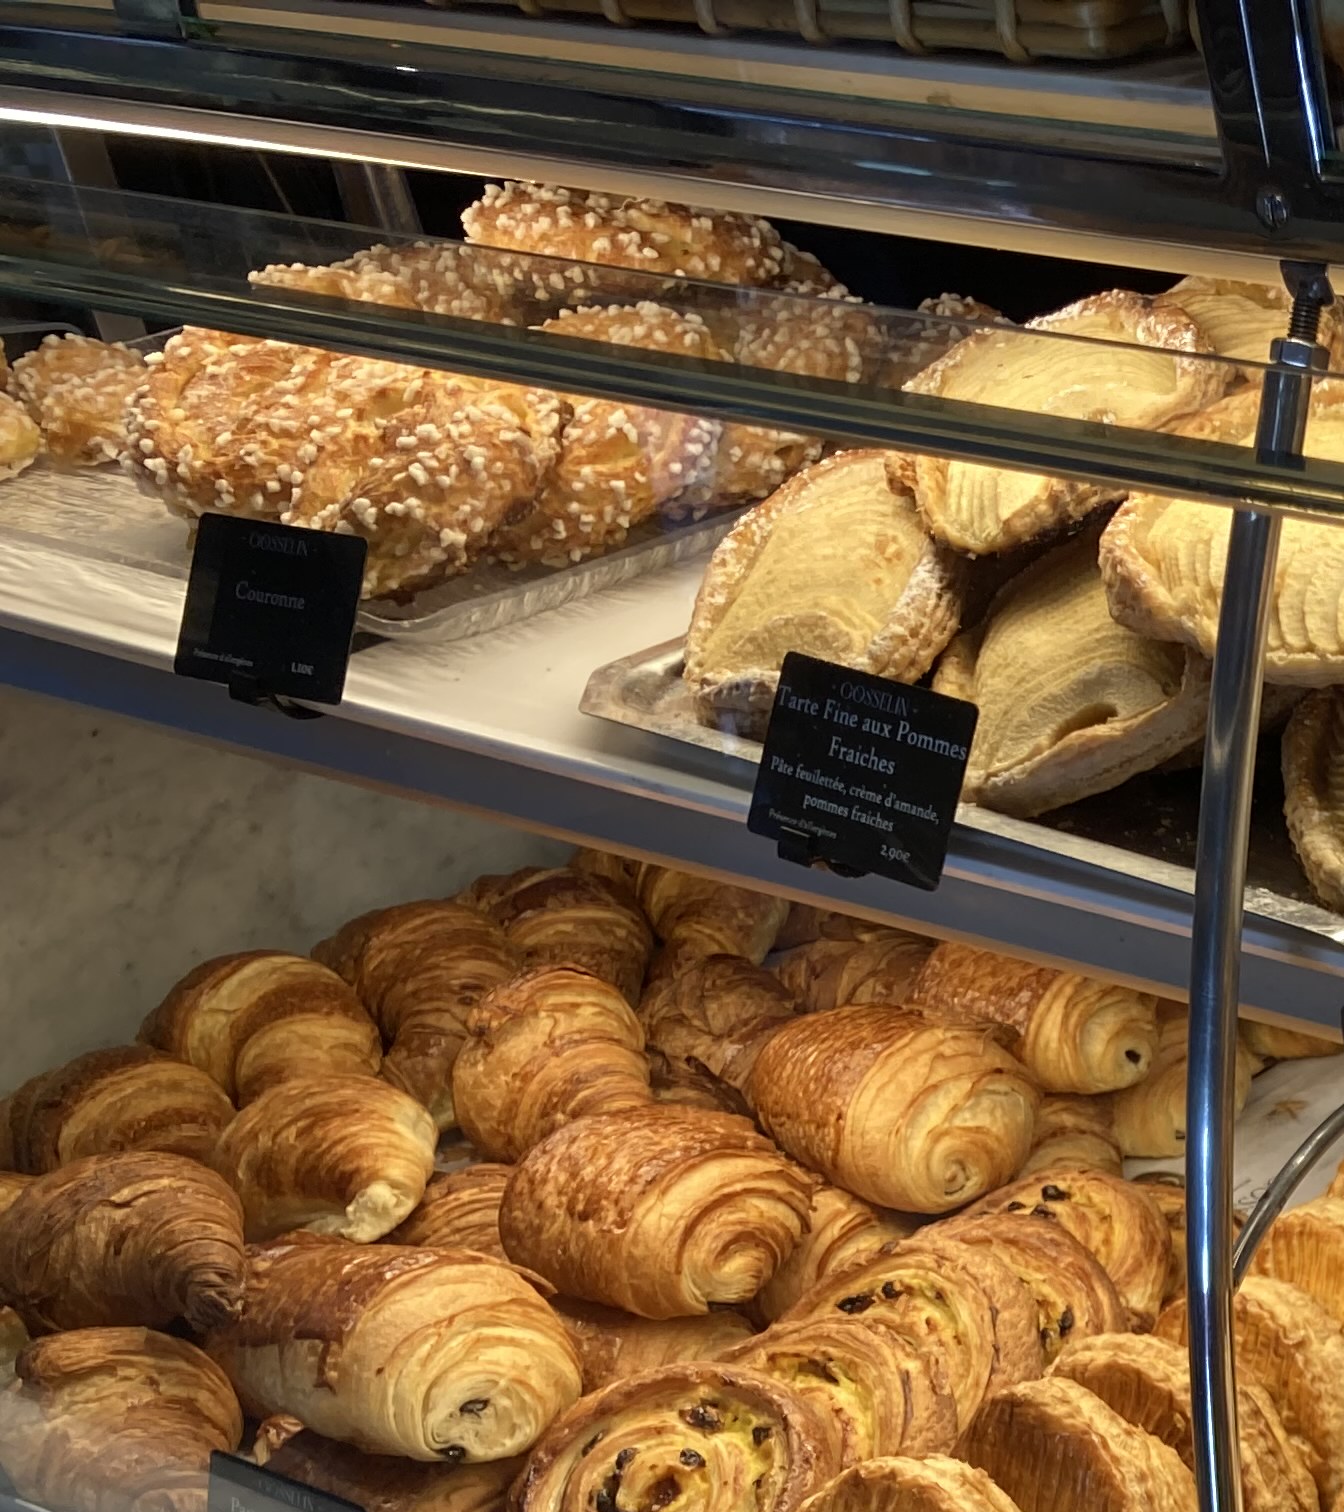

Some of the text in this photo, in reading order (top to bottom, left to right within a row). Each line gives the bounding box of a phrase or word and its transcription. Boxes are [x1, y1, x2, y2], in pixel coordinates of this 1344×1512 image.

[248, 531, 309, 557] GOSSELIN
[235, 581, 305, 609] Couronne
[840, 681, 911, 717] GOSSELIN
[778, 684, 968, 761] Tarte Fine aux Pommes
[828, 735, 896, 776] Fraiches
[770, 755, 794, 775] Pâte
[849, 784, 882, 805] crème
[884, 792, 940, 825] d'amande,
[803, 794, 849, 818] pommes
[851, 805, 894, 833] fraiches
